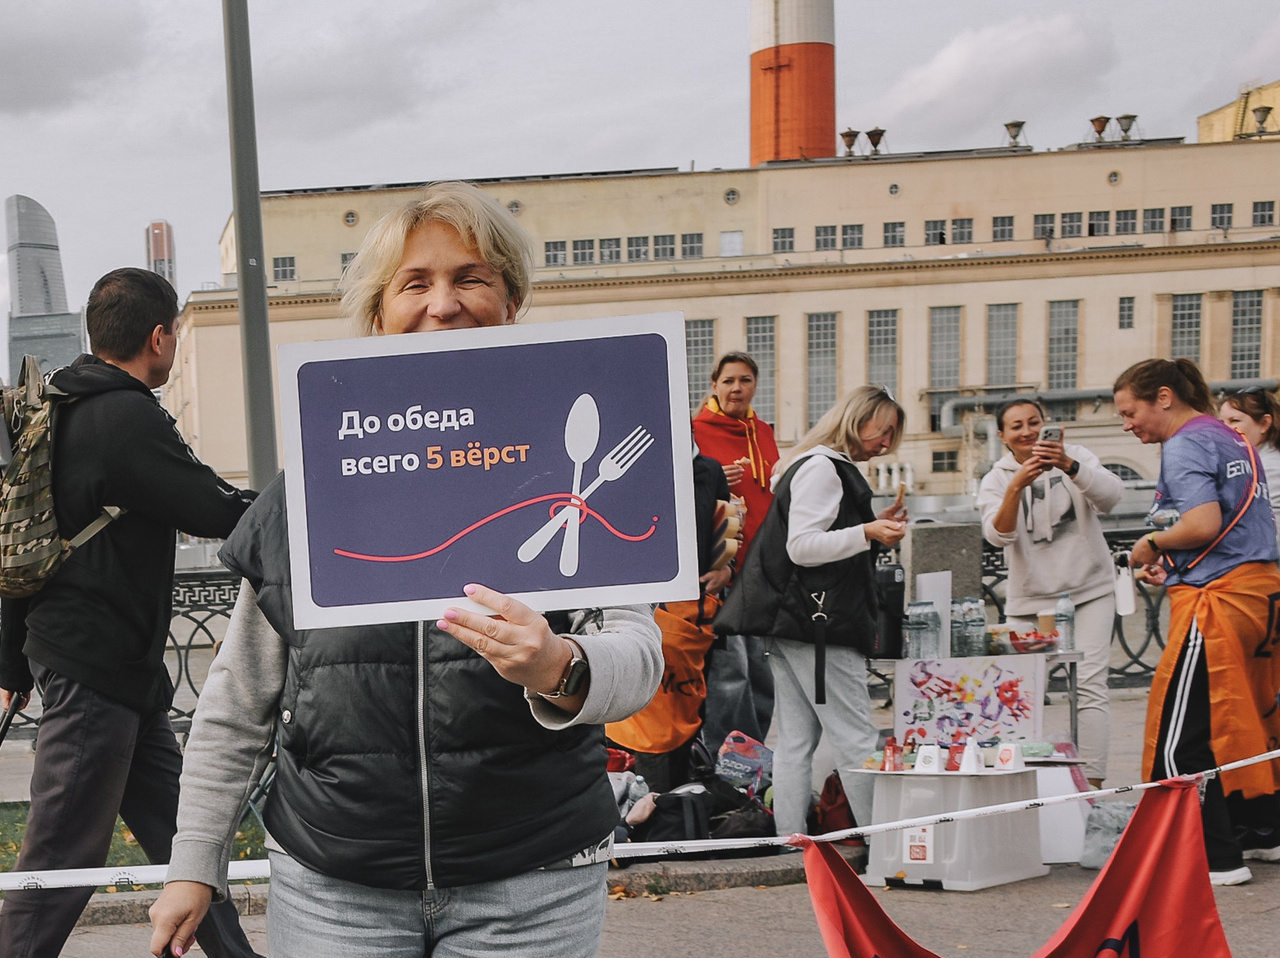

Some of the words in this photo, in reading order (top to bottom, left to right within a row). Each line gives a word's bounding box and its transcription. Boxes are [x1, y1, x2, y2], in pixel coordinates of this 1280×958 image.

[338, 410, 381, 440] До
[387, 405, 475, 432] обеда
[341, 453, 420, 476] всего
[426, 446, 443, 469] 5
[449, 442, 530, 471] вёрст
